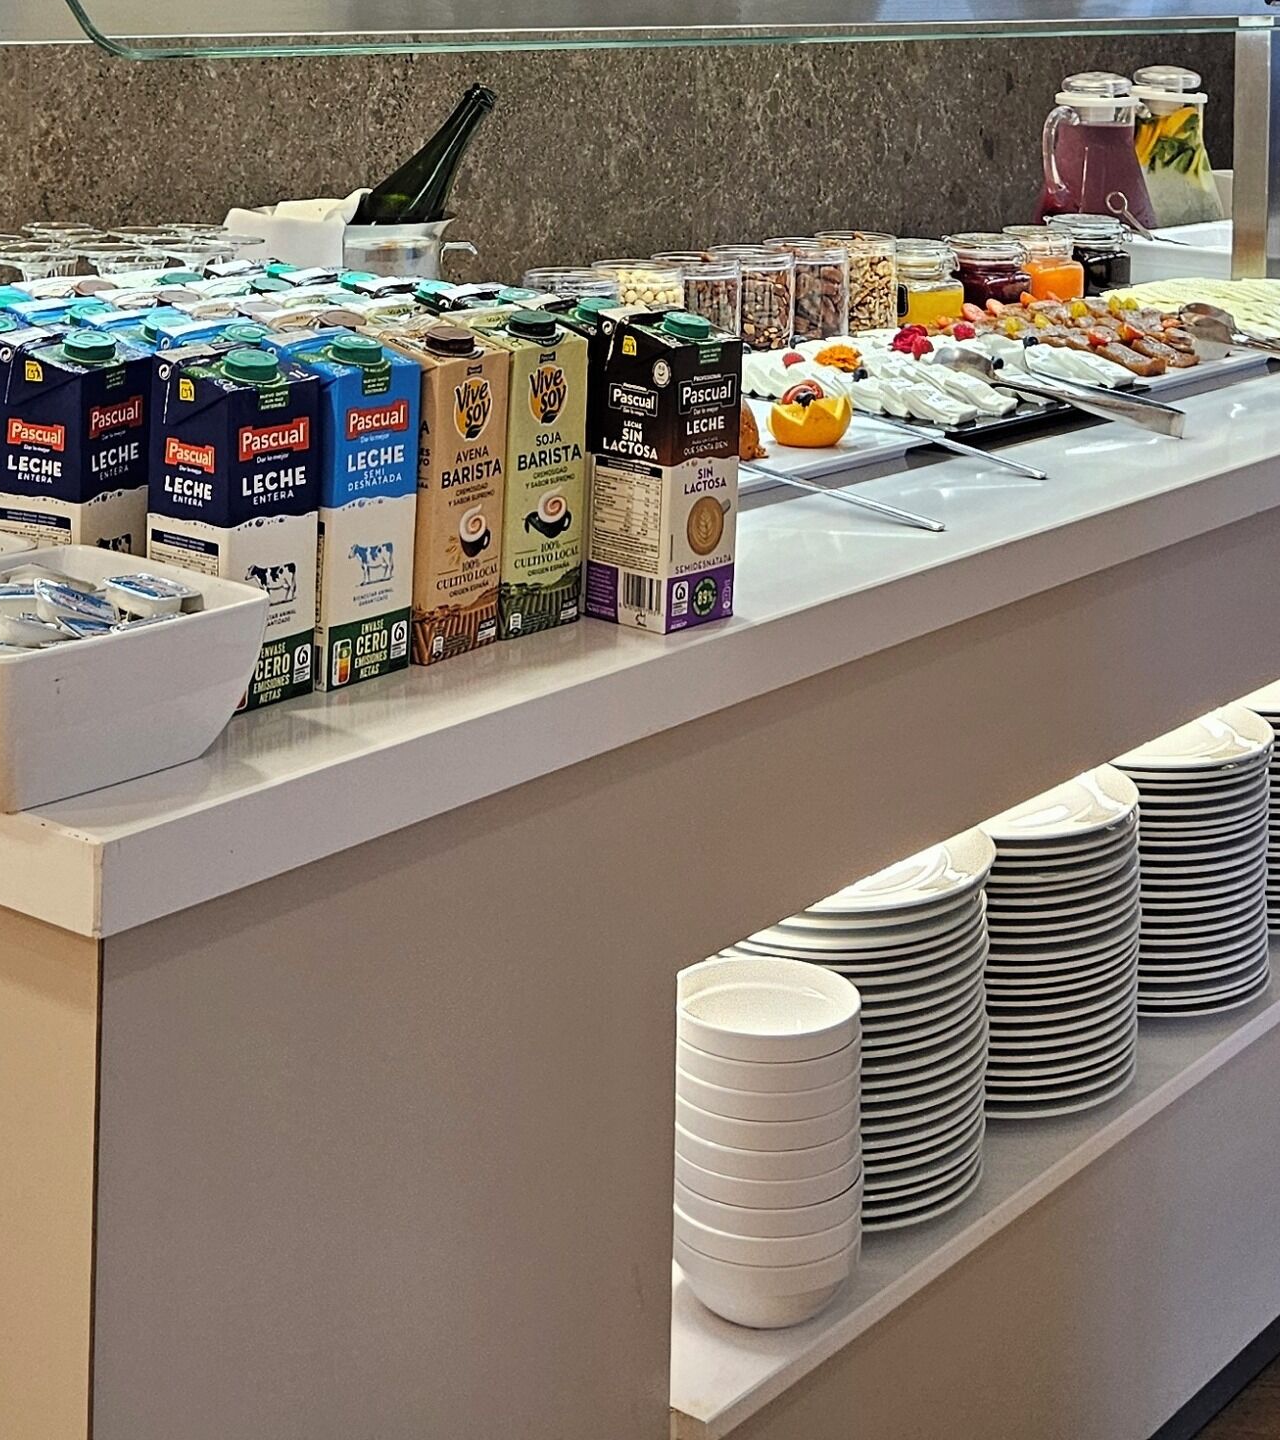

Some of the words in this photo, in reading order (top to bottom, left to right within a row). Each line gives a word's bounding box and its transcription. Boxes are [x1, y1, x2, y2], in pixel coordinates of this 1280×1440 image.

[530, 369, 563, 398] Vive
[682, 380, 732, 405] Pascual
[455, 381, 489, 413] Vive
[540, 385, 567, 413] soy
[613, 388, 655, 409] Pascual
[92, 401, 139, 431] Pascual
[349, 404, 404, 433] Pascual
[464, 398, 491, 428] soy
[11, 422, 61, 445] Pascual
[624, 420, 642, 430] LECHE
[686, 416, 725, 436] LECHE
[242, 423, 305, 452] Pascual
[535, 432, 562, 447] SOJA
[622, 428, 642, 443] SIN
[91, 442, 139, 472] LECHE
[169, 442, 212, 466] Pascual
[456, 445, 489, 464] AVENA
[517, 443, 582, 471] BARISTA
[603, 436, 658, 460] LACTOSA
[7, 454, 62, 477] LECHE
[347, 444, 404, 473] LECHE
[18, 472, 53, 484] ENTERA
[100, 464, 129, 481] ENTERA
[242, 465, 307, 497] LECHE
[347, 472, 402, 492] DESNATADA
[363, 467, 385, 480] SEMI
[441, 458, 502, 489] BARISTA
[533, 466, 568, 480] CREMOSIDAD
[697, 466, 714, 480] SIN
[164, 475, 213, 501] LECHE
[455, 482, 489, 497] CREMOSIDAD
[531, 478, 549, 489] SABOR
[684, 477, 727, 495] LACTOSA
[173, 494, 203, 508] ENTERA
[253, 490, 295, 506] ENTERA
[454, 495, 471, 506] SABOR
[541, 541, 561, 552] 100%
[462, 560, 481, 572] 100%
[514, 553, 553, 569] CULTIVO
[555, 545, 579, 561] LOCAL
[675, 553, 732, 575] SEMIDESNATADA
[436, 571, 474, 591] CULTIVO
[475, 563, 498, 580] LOCAL
[697, 590, 713, 606] 89%
[361, 618, 384, 635] ENVASE
[260, 641, 287, 659] ENVASE
[356, 629, 388, 656] CERO
[255, 653, 291, 682] CERO
[354, 650, 388, 669] EMISIONES
[359, 663, 380, 679] NETAS
[253, 674, 291, 695] EMISIONES
[259, 688, 282, 705] NETAS
